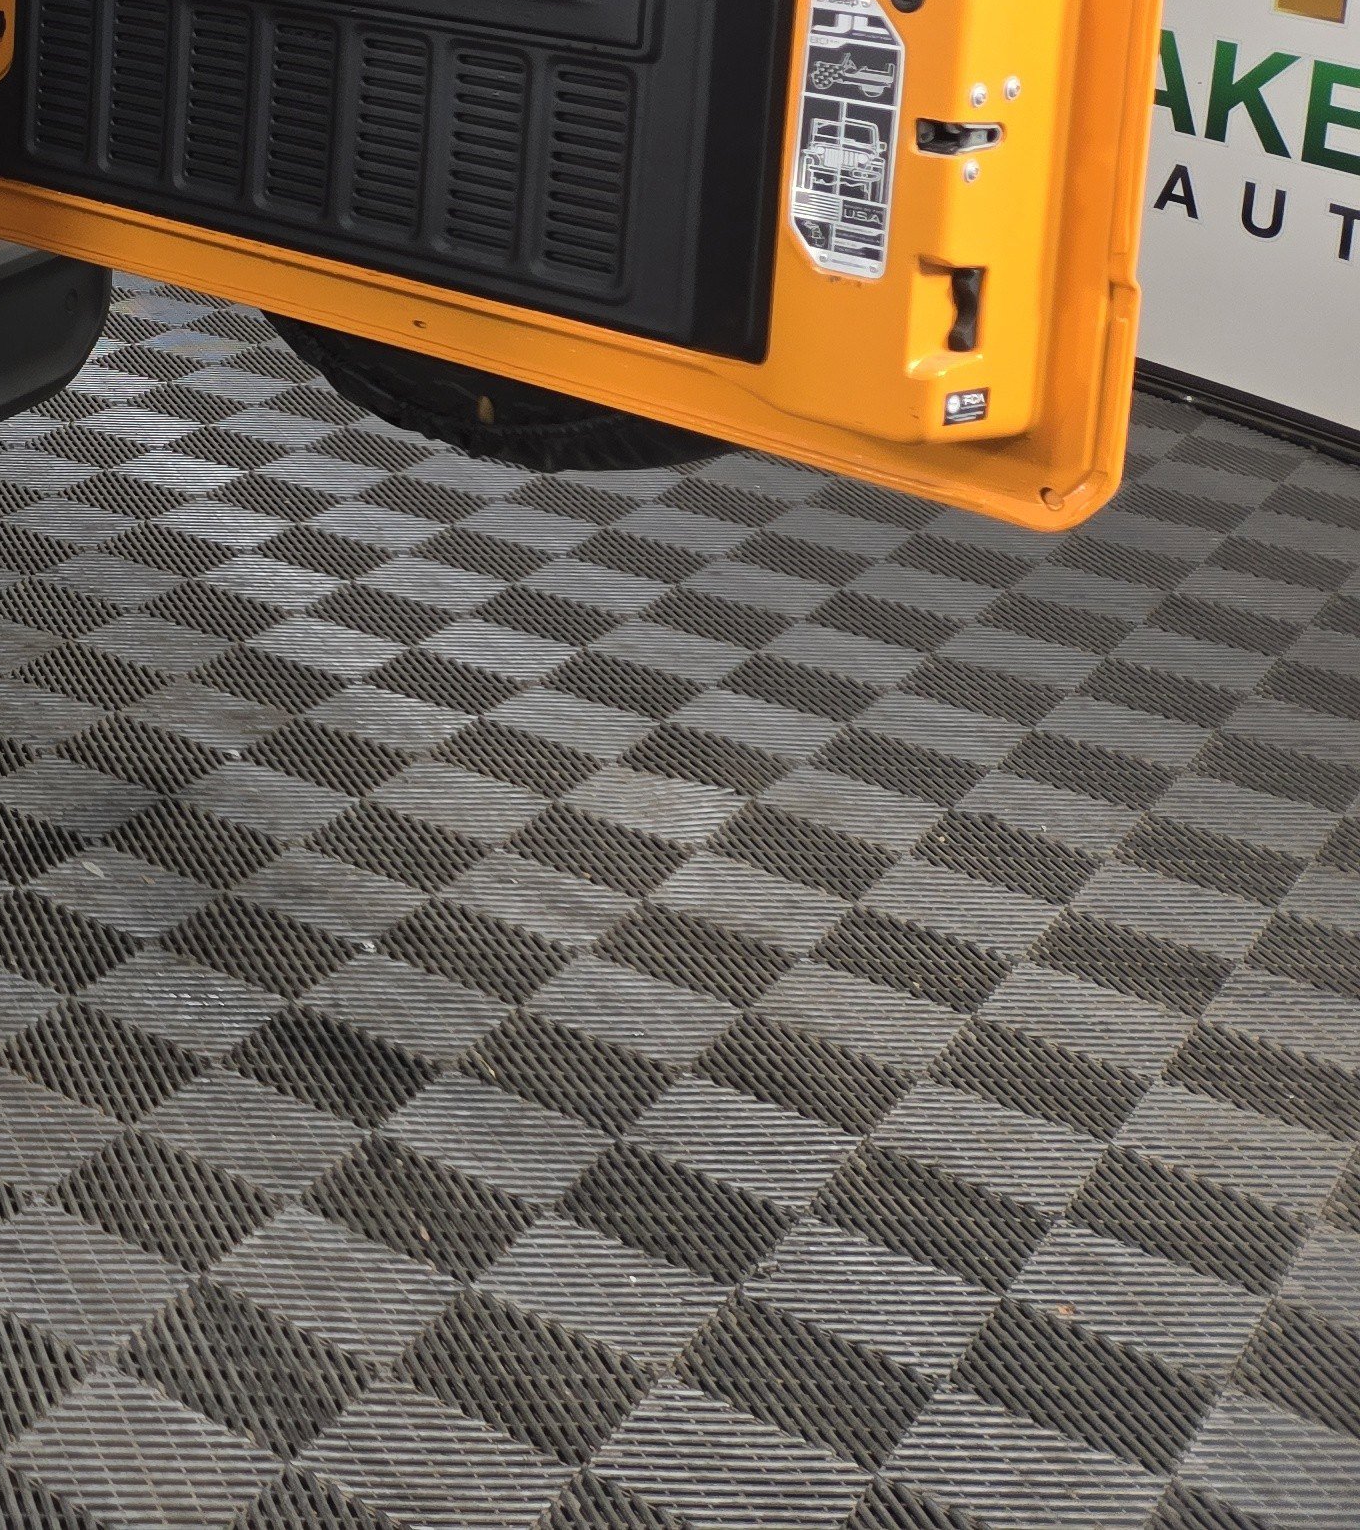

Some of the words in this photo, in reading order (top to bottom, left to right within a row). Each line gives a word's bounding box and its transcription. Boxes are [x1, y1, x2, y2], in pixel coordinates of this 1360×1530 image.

[1154, 28, 1360, 177] AKE
[843, 208, 882, 225] USA
[1153, 163, 1360, 262] AUT
